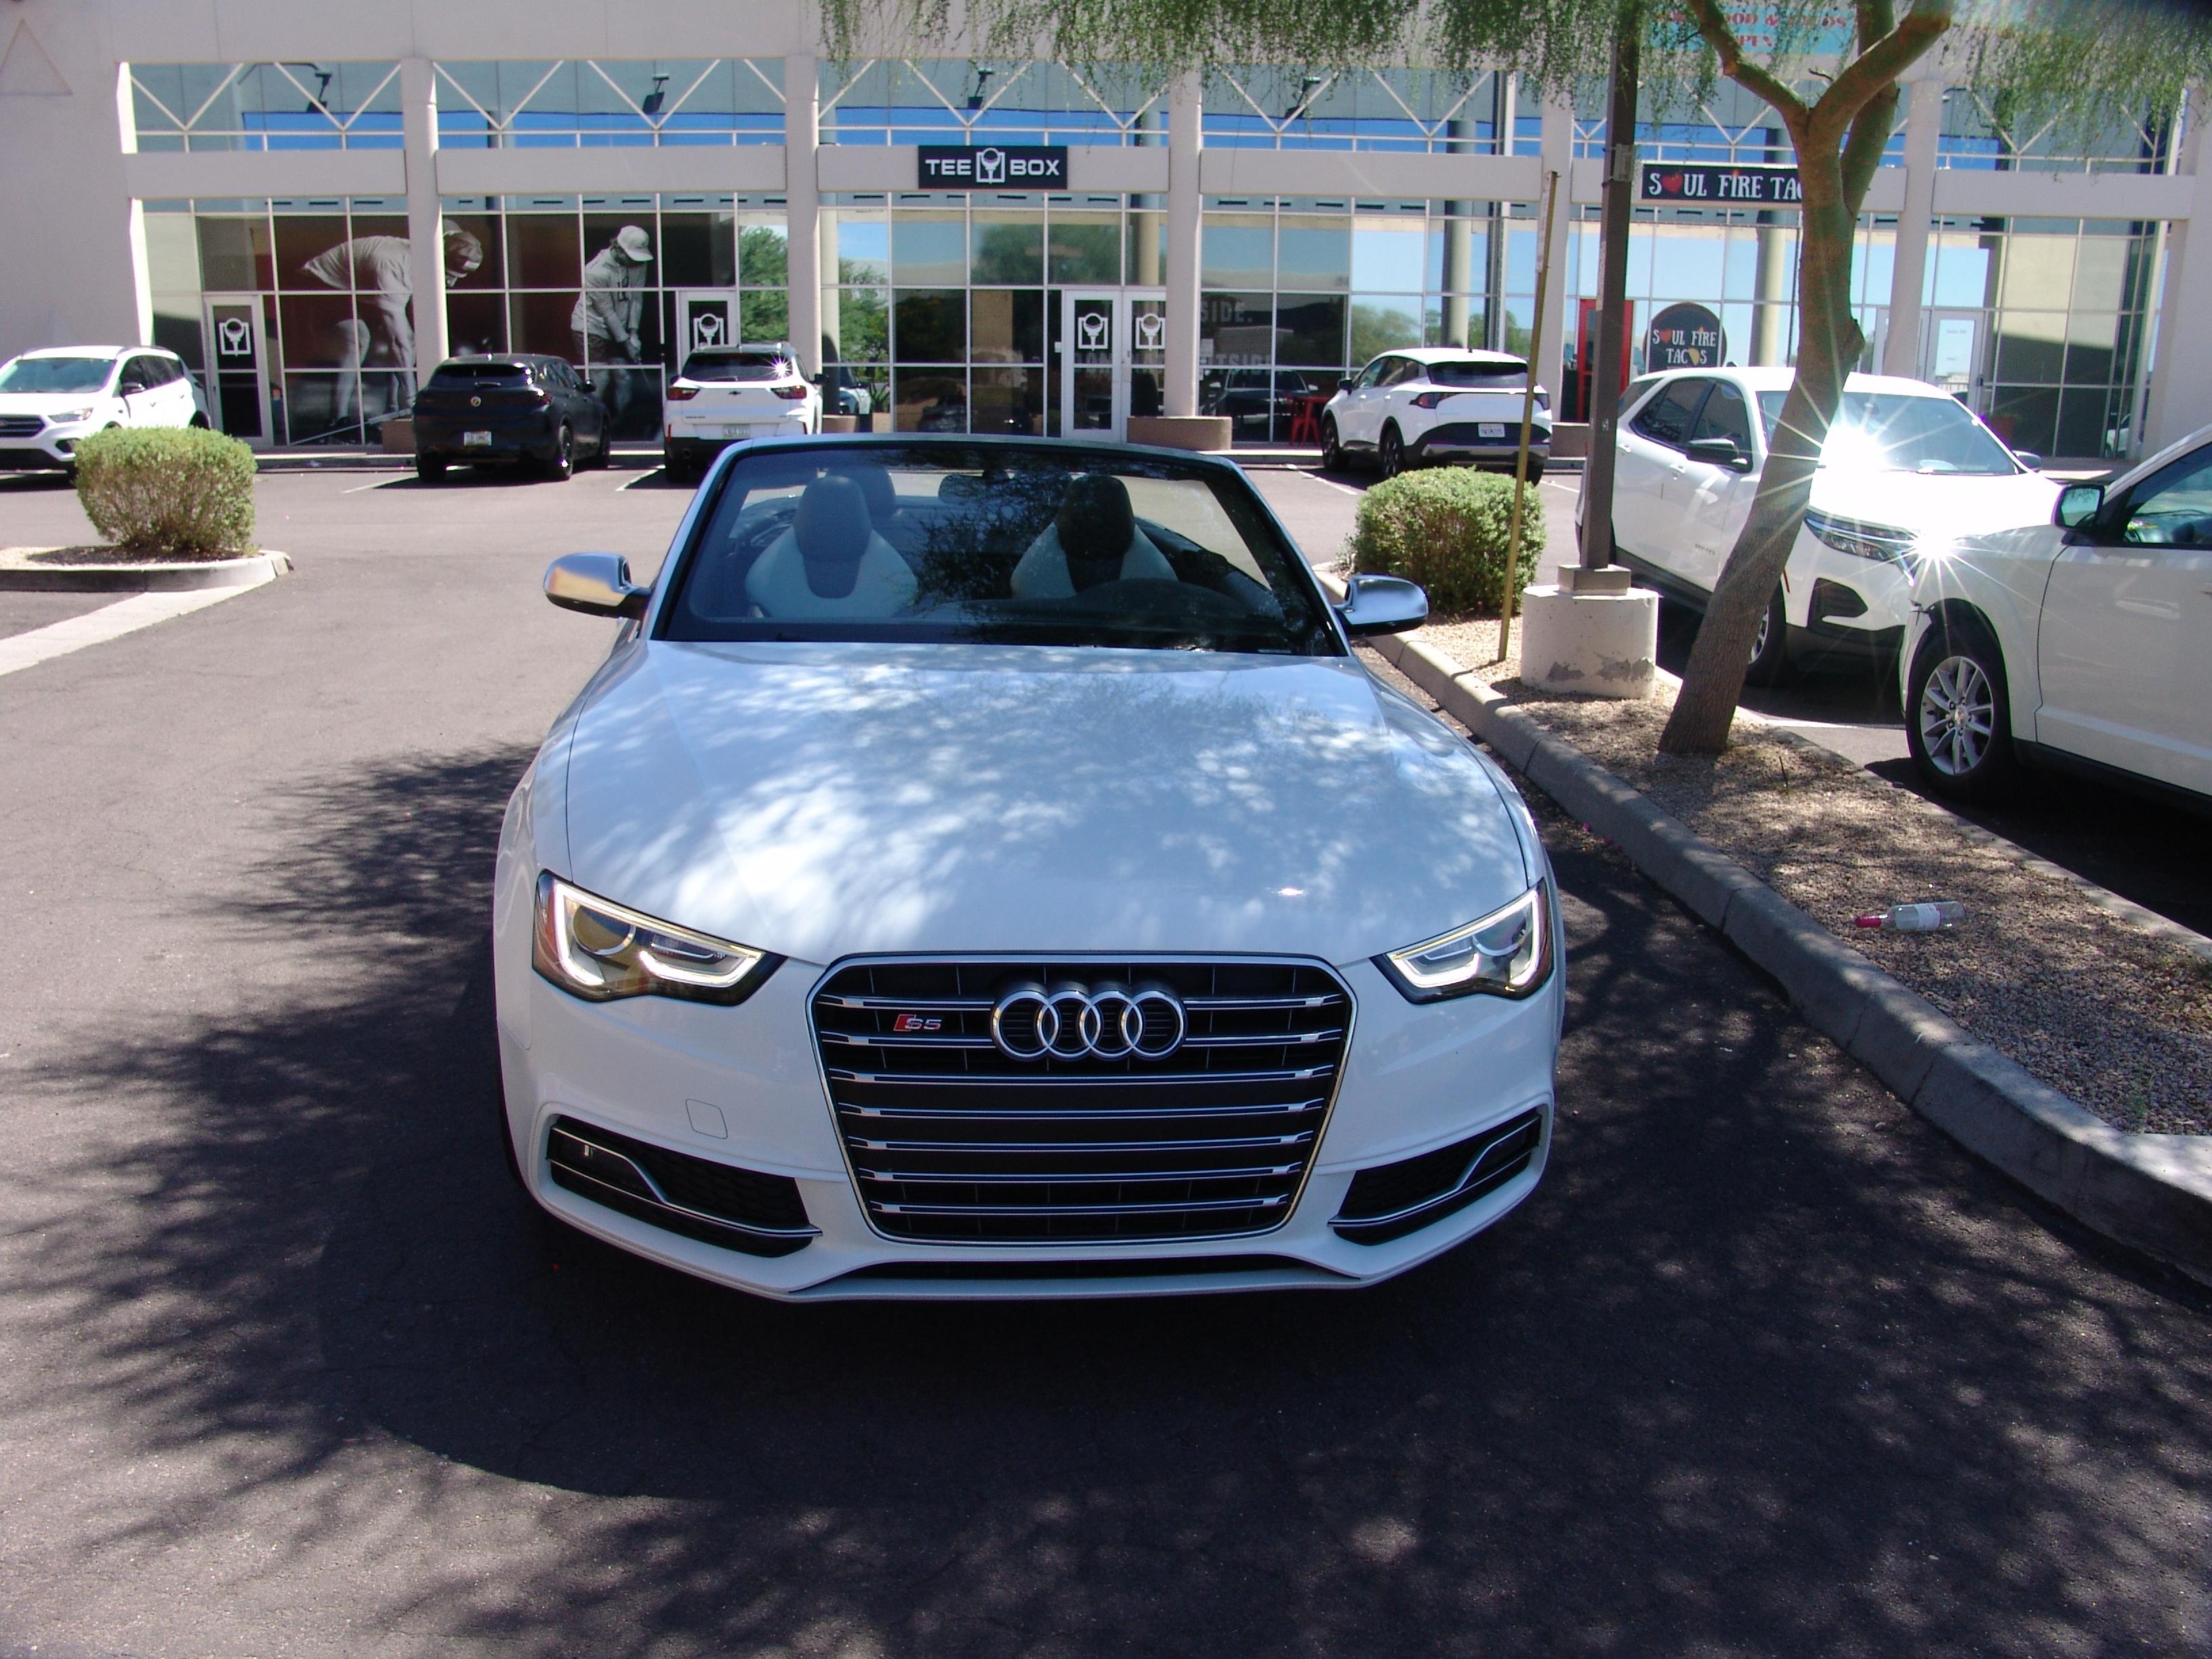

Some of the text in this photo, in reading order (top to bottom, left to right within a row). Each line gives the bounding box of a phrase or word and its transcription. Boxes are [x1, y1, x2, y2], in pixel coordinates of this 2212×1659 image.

[924, 159, 1061, 176] TEE BOX
[1717, 173, 1764, 199] FIRE
[1691, 329, 1718, 347] FIRE
[903, 1017, 943, 1030] S5
